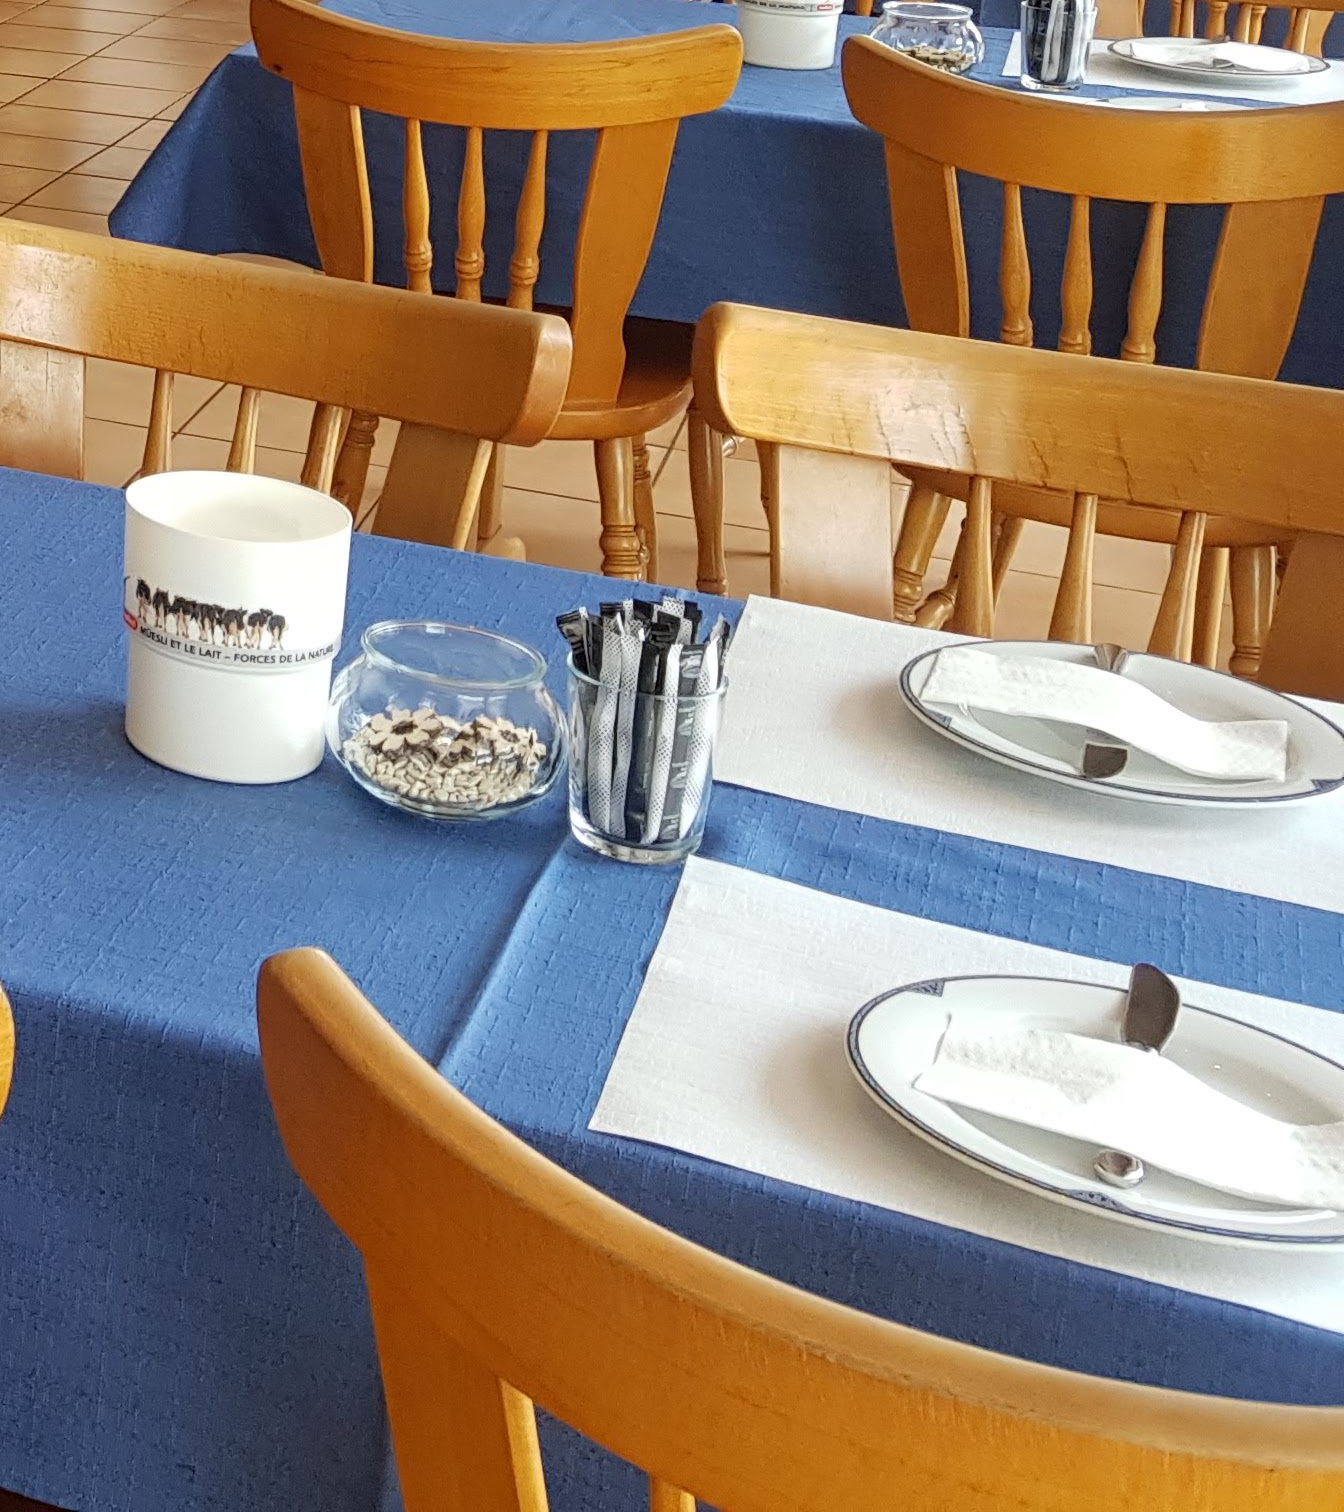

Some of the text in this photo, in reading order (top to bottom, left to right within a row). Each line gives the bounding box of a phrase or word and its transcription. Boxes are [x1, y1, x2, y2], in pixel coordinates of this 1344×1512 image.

[170, 640, 181, 649] ET
[184, 643, 196, 654] LE
[199, 647, 222, 659] LAIT
[233, 653, 276, 664] FORCES
[279, 654, 293, 664] DE
[295, 653, 306, 662] LA
